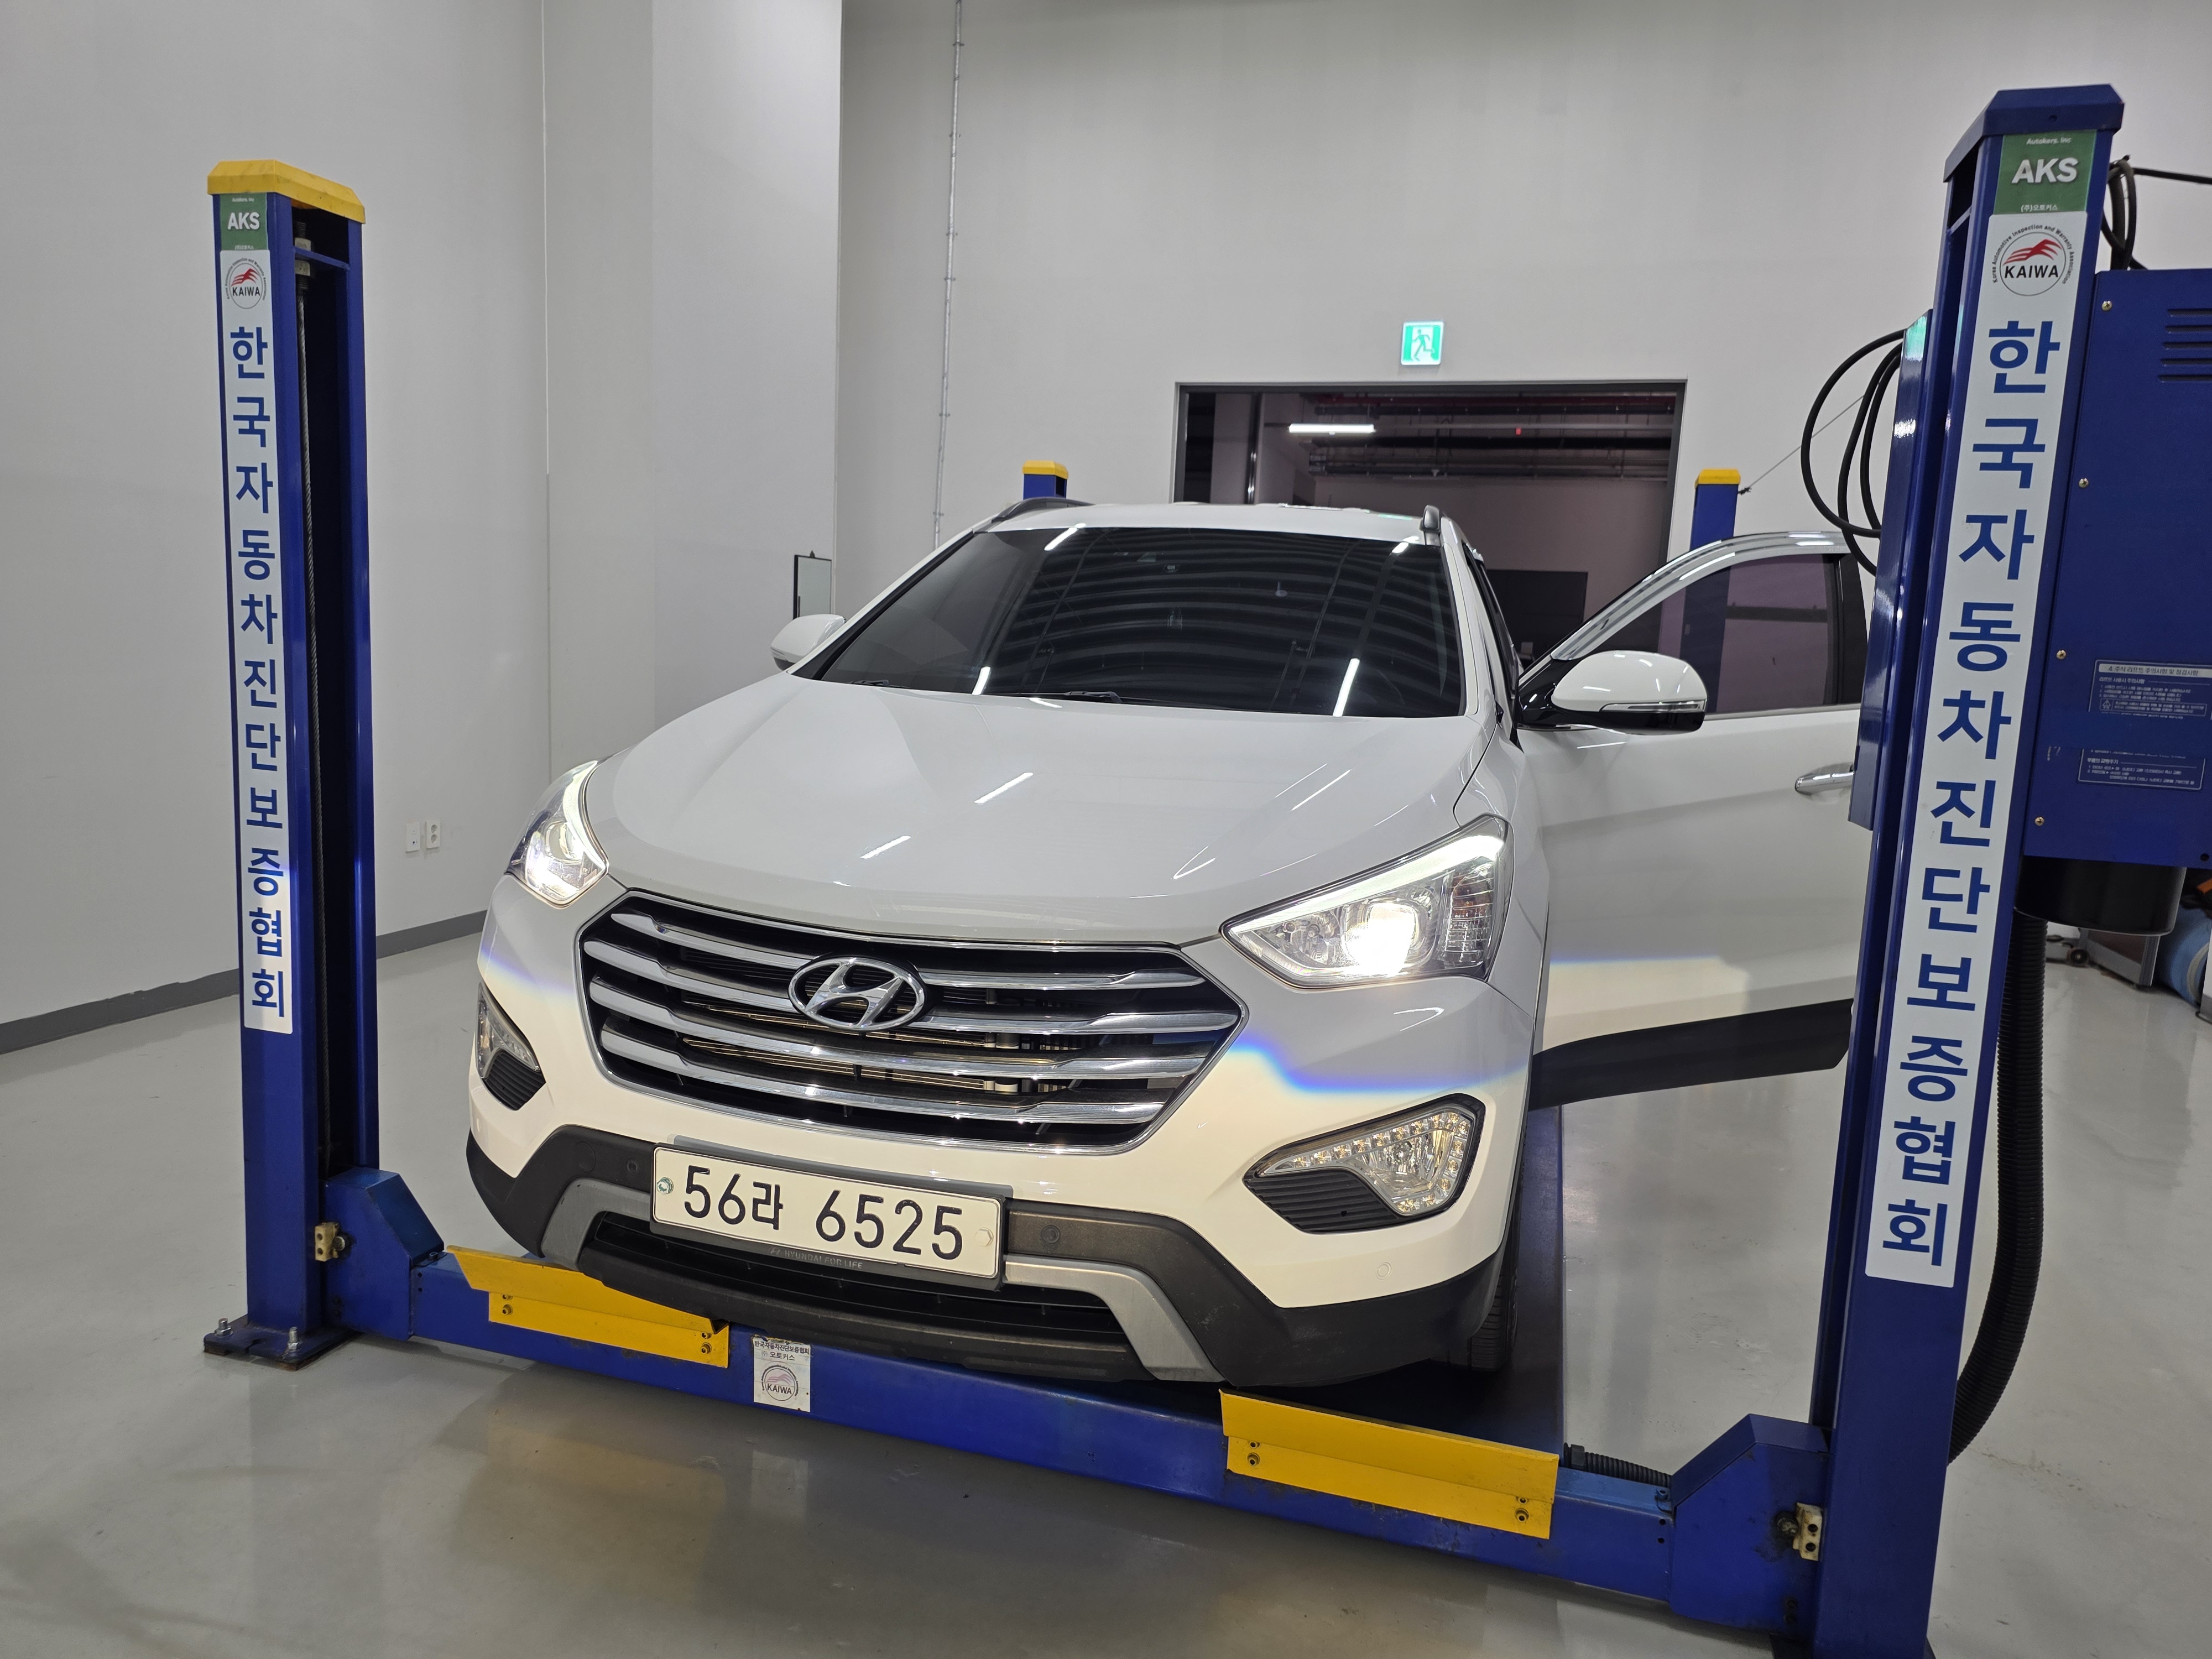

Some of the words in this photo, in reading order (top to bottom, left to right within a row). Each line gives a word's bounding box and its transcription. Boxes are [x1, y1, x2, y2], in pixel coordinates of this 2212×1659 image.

[2011, 157, 2079, 184] AKS
[228, 212, 260, 230] AKS
[2012, 225, 2043, 237] Inspection
[2056, 228, 2073, 249] Warranty
[2004, 265, 2059, 278] KAIWA
[232, 286, 260, 296] KAIWA
[231, 326, 284, 1018] 한국자동차진단보증협회
[1883, 321, 2061, 1266] 한국자동차진단보증협회
[684, 1165, 783, 1230] 56라
[816, 1190, 962, 1260] 6525
[785, 1250, 822, 1262] HYUNDAI
[825, 1256, 842, 1265] FOR
[844, 1260, 863, 1269] LIFE
[754, 1340, 810, 1354] 한국자동차진단보증협회
[770, 1352, 795, 1360] 오토커스
[767, 1383, 792, 1395] KAIWA
